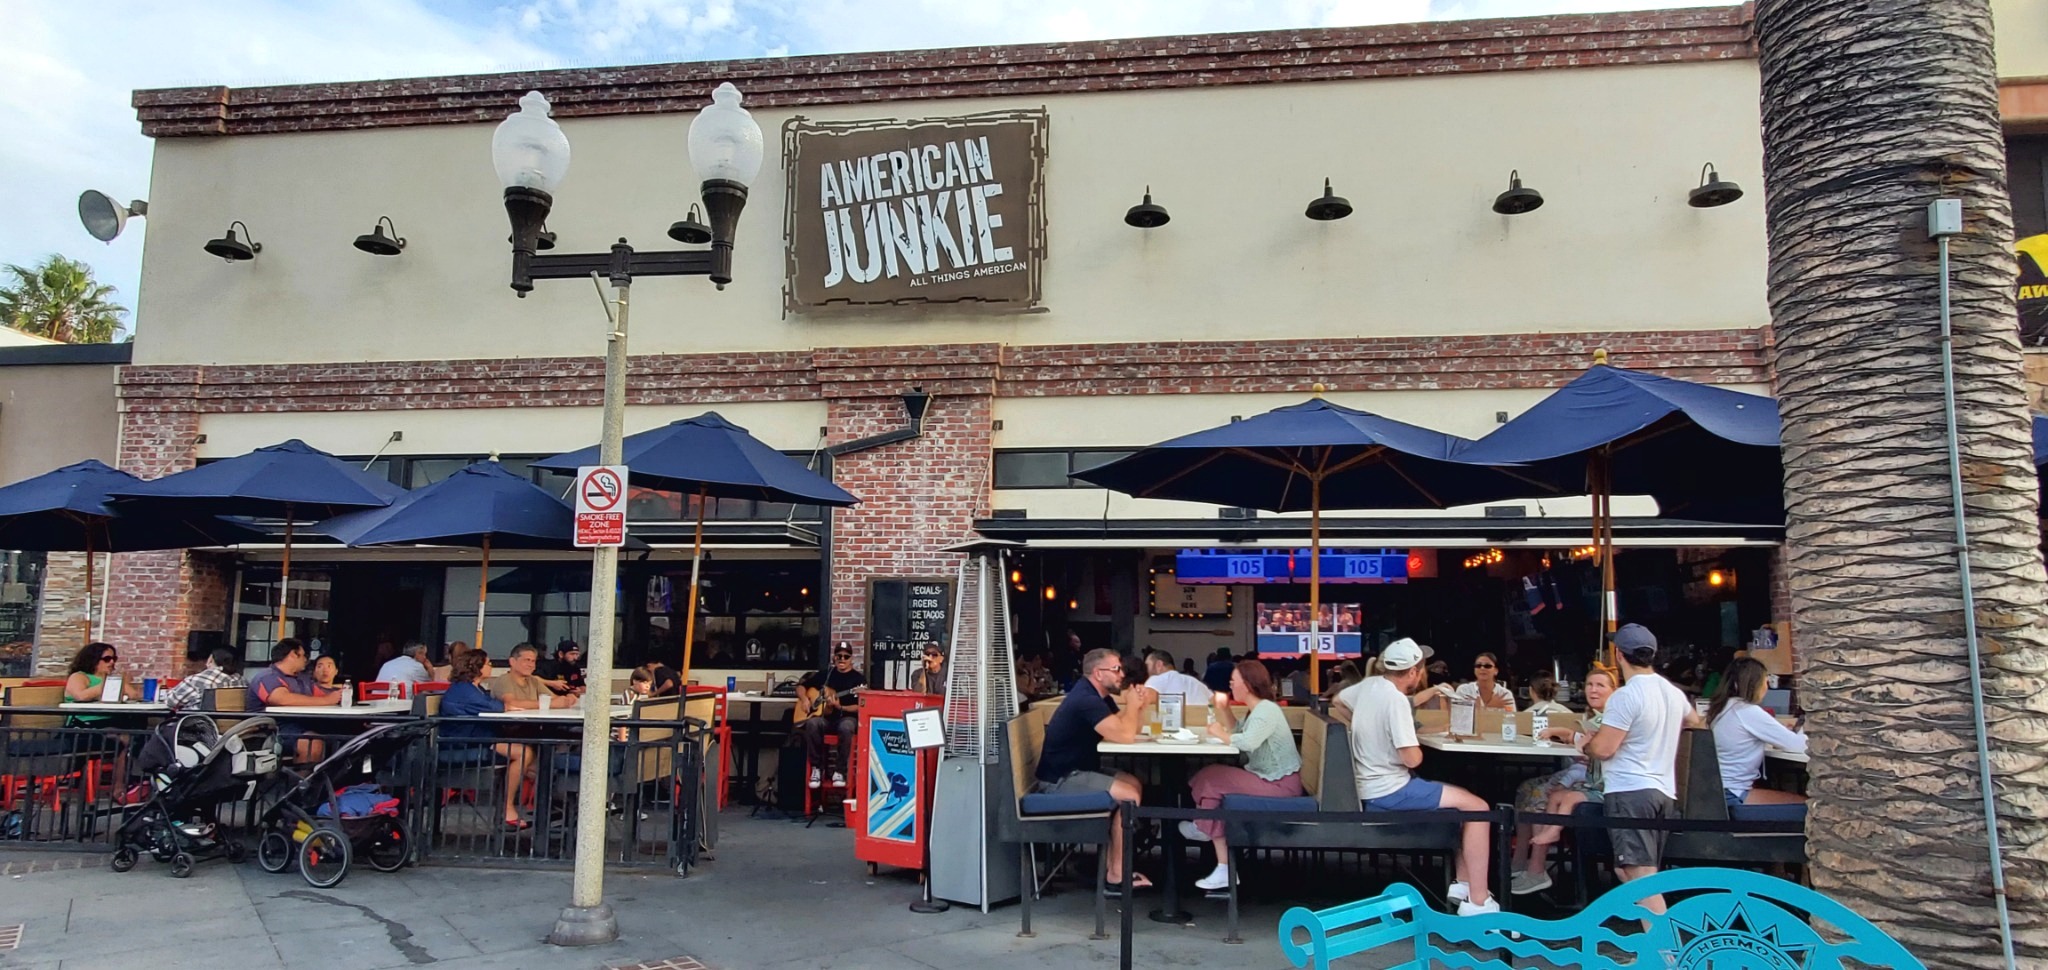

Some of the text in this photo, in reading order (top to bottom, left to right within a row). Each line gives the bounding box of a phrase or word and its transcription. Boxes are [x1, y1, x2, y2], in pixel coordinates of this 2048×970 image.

[820, 136, 994, 209] AMERICAN
[823, 183, 1014, 289] JUNKIE
[909, 261, 1028, 287] ALL THINGS AMERICAN
[1231, 560, 1261, 575] 105
[1348, 560, 1378, 575] 105
[912, 585, 942, 595] ECIALS-
[912, 599, 938, 608] RGERS
[922, 610, 945, 619] TACOS
[912, 631, 930, 640] ZAS
[1302, 637, 1331, 651] 15
